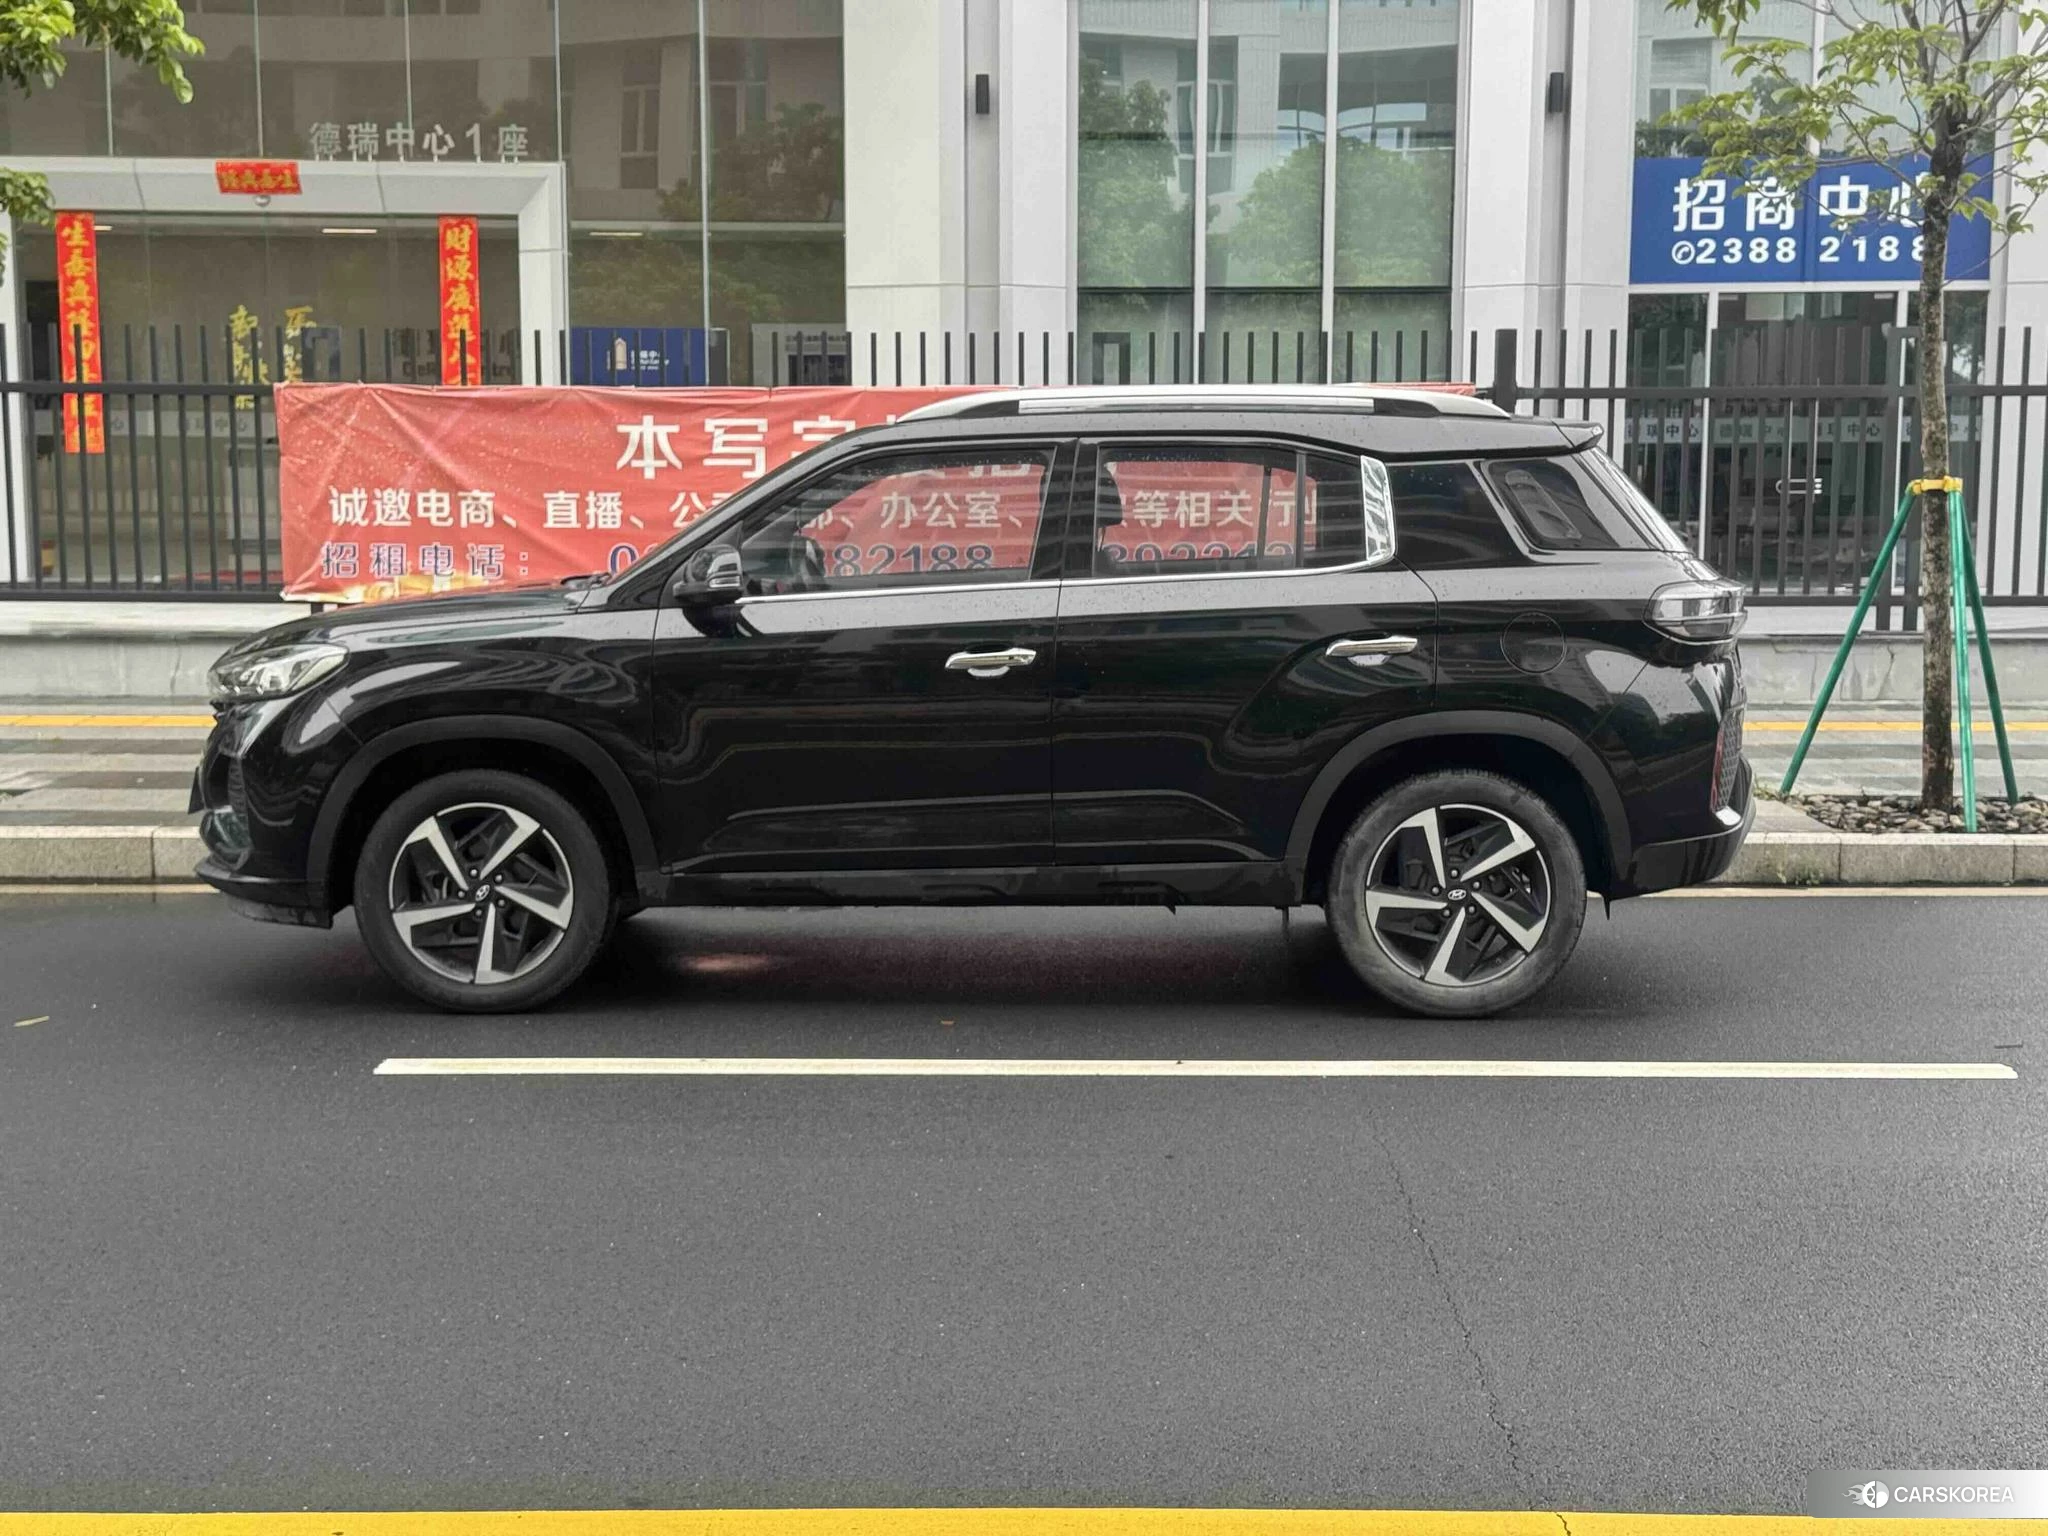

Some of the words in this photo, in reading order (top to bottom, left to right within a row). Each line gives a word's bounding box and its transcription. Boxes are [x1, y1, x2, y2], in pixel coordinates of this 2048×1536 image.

[309, 121, 529, 156] 德瑞中心1座
[1695, 237, 1796, 265] 2388
[616, 414, 896, 480] 本写字
[822, 543, 994, 577] 82188
